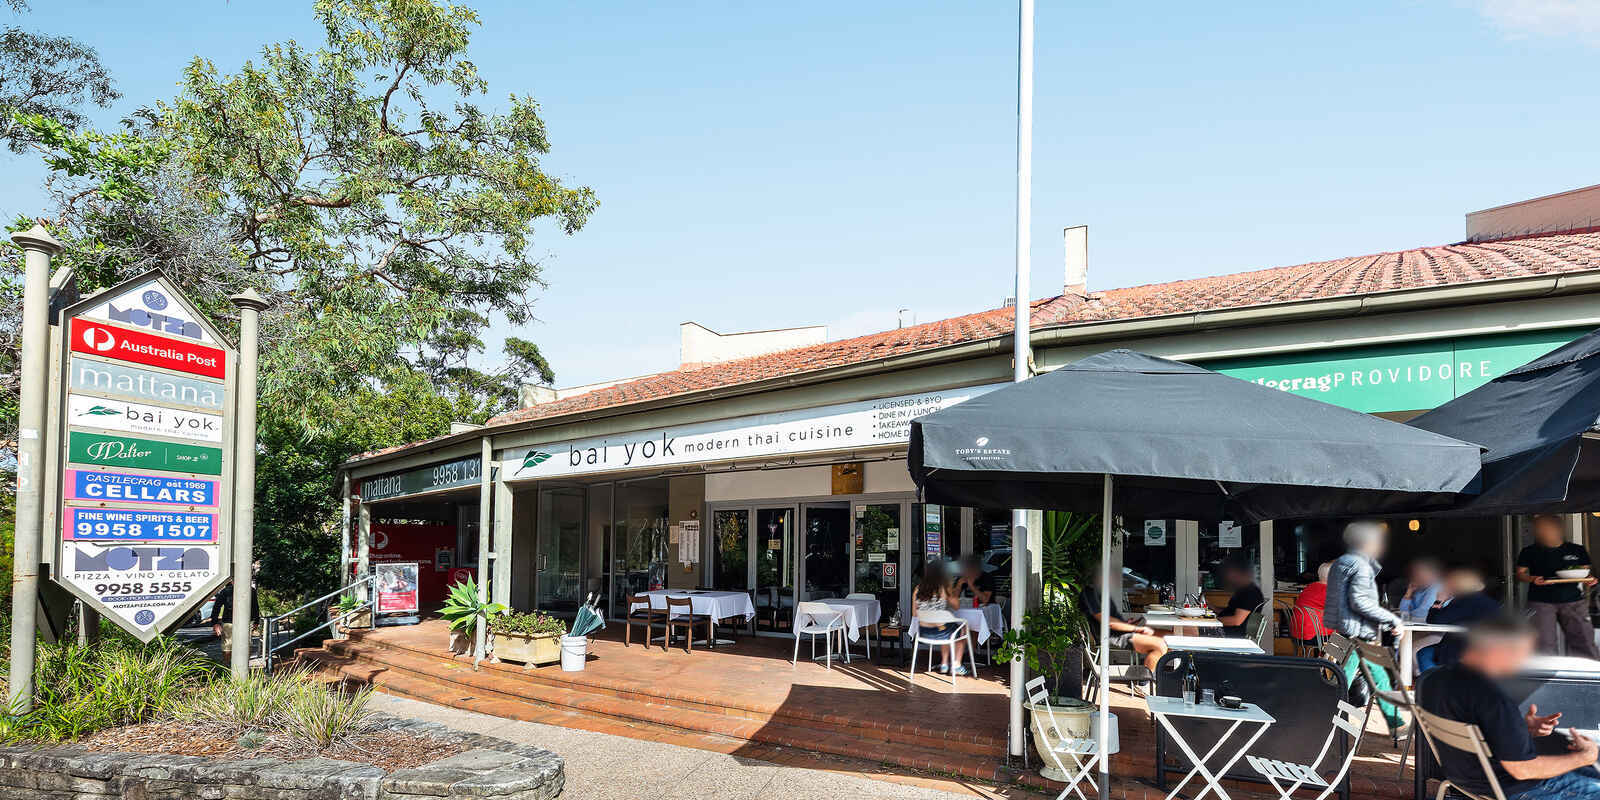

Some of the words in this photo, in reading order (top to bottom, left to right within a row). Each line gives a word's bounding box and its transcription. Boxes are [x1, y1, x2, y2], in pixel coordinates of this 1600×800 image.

[108, 302, 203, 341] MOTZA
[120, 339, 185, 361] Australia
[187, 351, 217, 368] Post
[79, 366, 217, 406] mattana
[878, 399, 915, 410] LICENSED
[916, 398, 922, 406] &
[924, 395, 942, 405] BYO
[126, 406, 163, 424] bai
[174, 415, 214, 431] yok
[878, 411, 896, 420] DINE
[897, 410, 906, 418] IN
[878, 431, 903, 440] HOME
[86, 440, 152, 460] Walter
[569, 440, 608, 467] bai
[624, 432, 676, 466] yok
[684, 438, 740, 453] modern
[747, 431, 779, 447] thai
[788, 425, 854, 442] cuisine
[86, 473, 162, 487] CASTLECRAG
[166, 480, 182, 488] est
[364, 475, 401, 499] mattana
[432, 464, 458, 486] 9958
[462, 458, 481, 481] 131
[85, 483, 206, 503] CELLARS
[78, 511, 103, 521] FINE
[106, 513, 133, 522] WINE
[135, 514, 173, 523] SPIRITS
[175, 515, 183, 523] &
[185, 516, 209, 524] BEER
[77, 522, 142, 537] 9958
[153, 524, 210, 537] 1507
[75, 547, 210, 572] MOTZA
[94, 583, 144, 596] 9958
[149, 581, 192, 594] 5555
